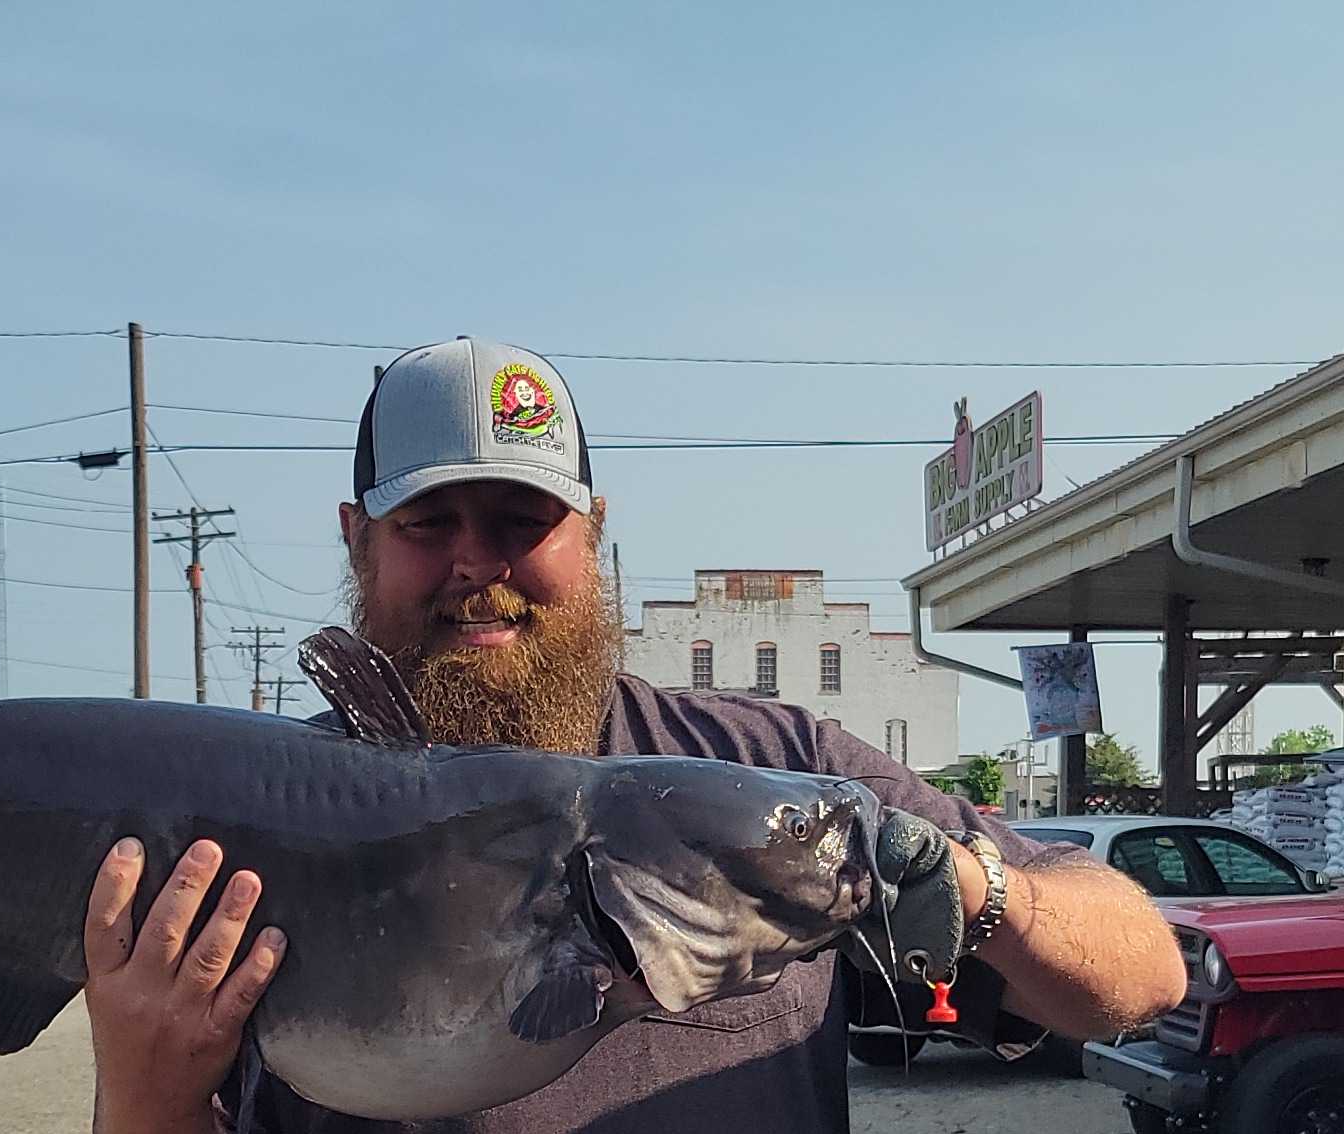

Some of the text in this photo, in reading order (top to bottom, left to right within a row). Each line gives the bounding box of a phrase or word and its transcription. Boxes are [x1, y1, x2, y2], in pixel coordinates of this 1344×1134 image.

[930, 402, 1032, 511] BIG APPLE
[974, 469, 1016, 519] SUPPLY
